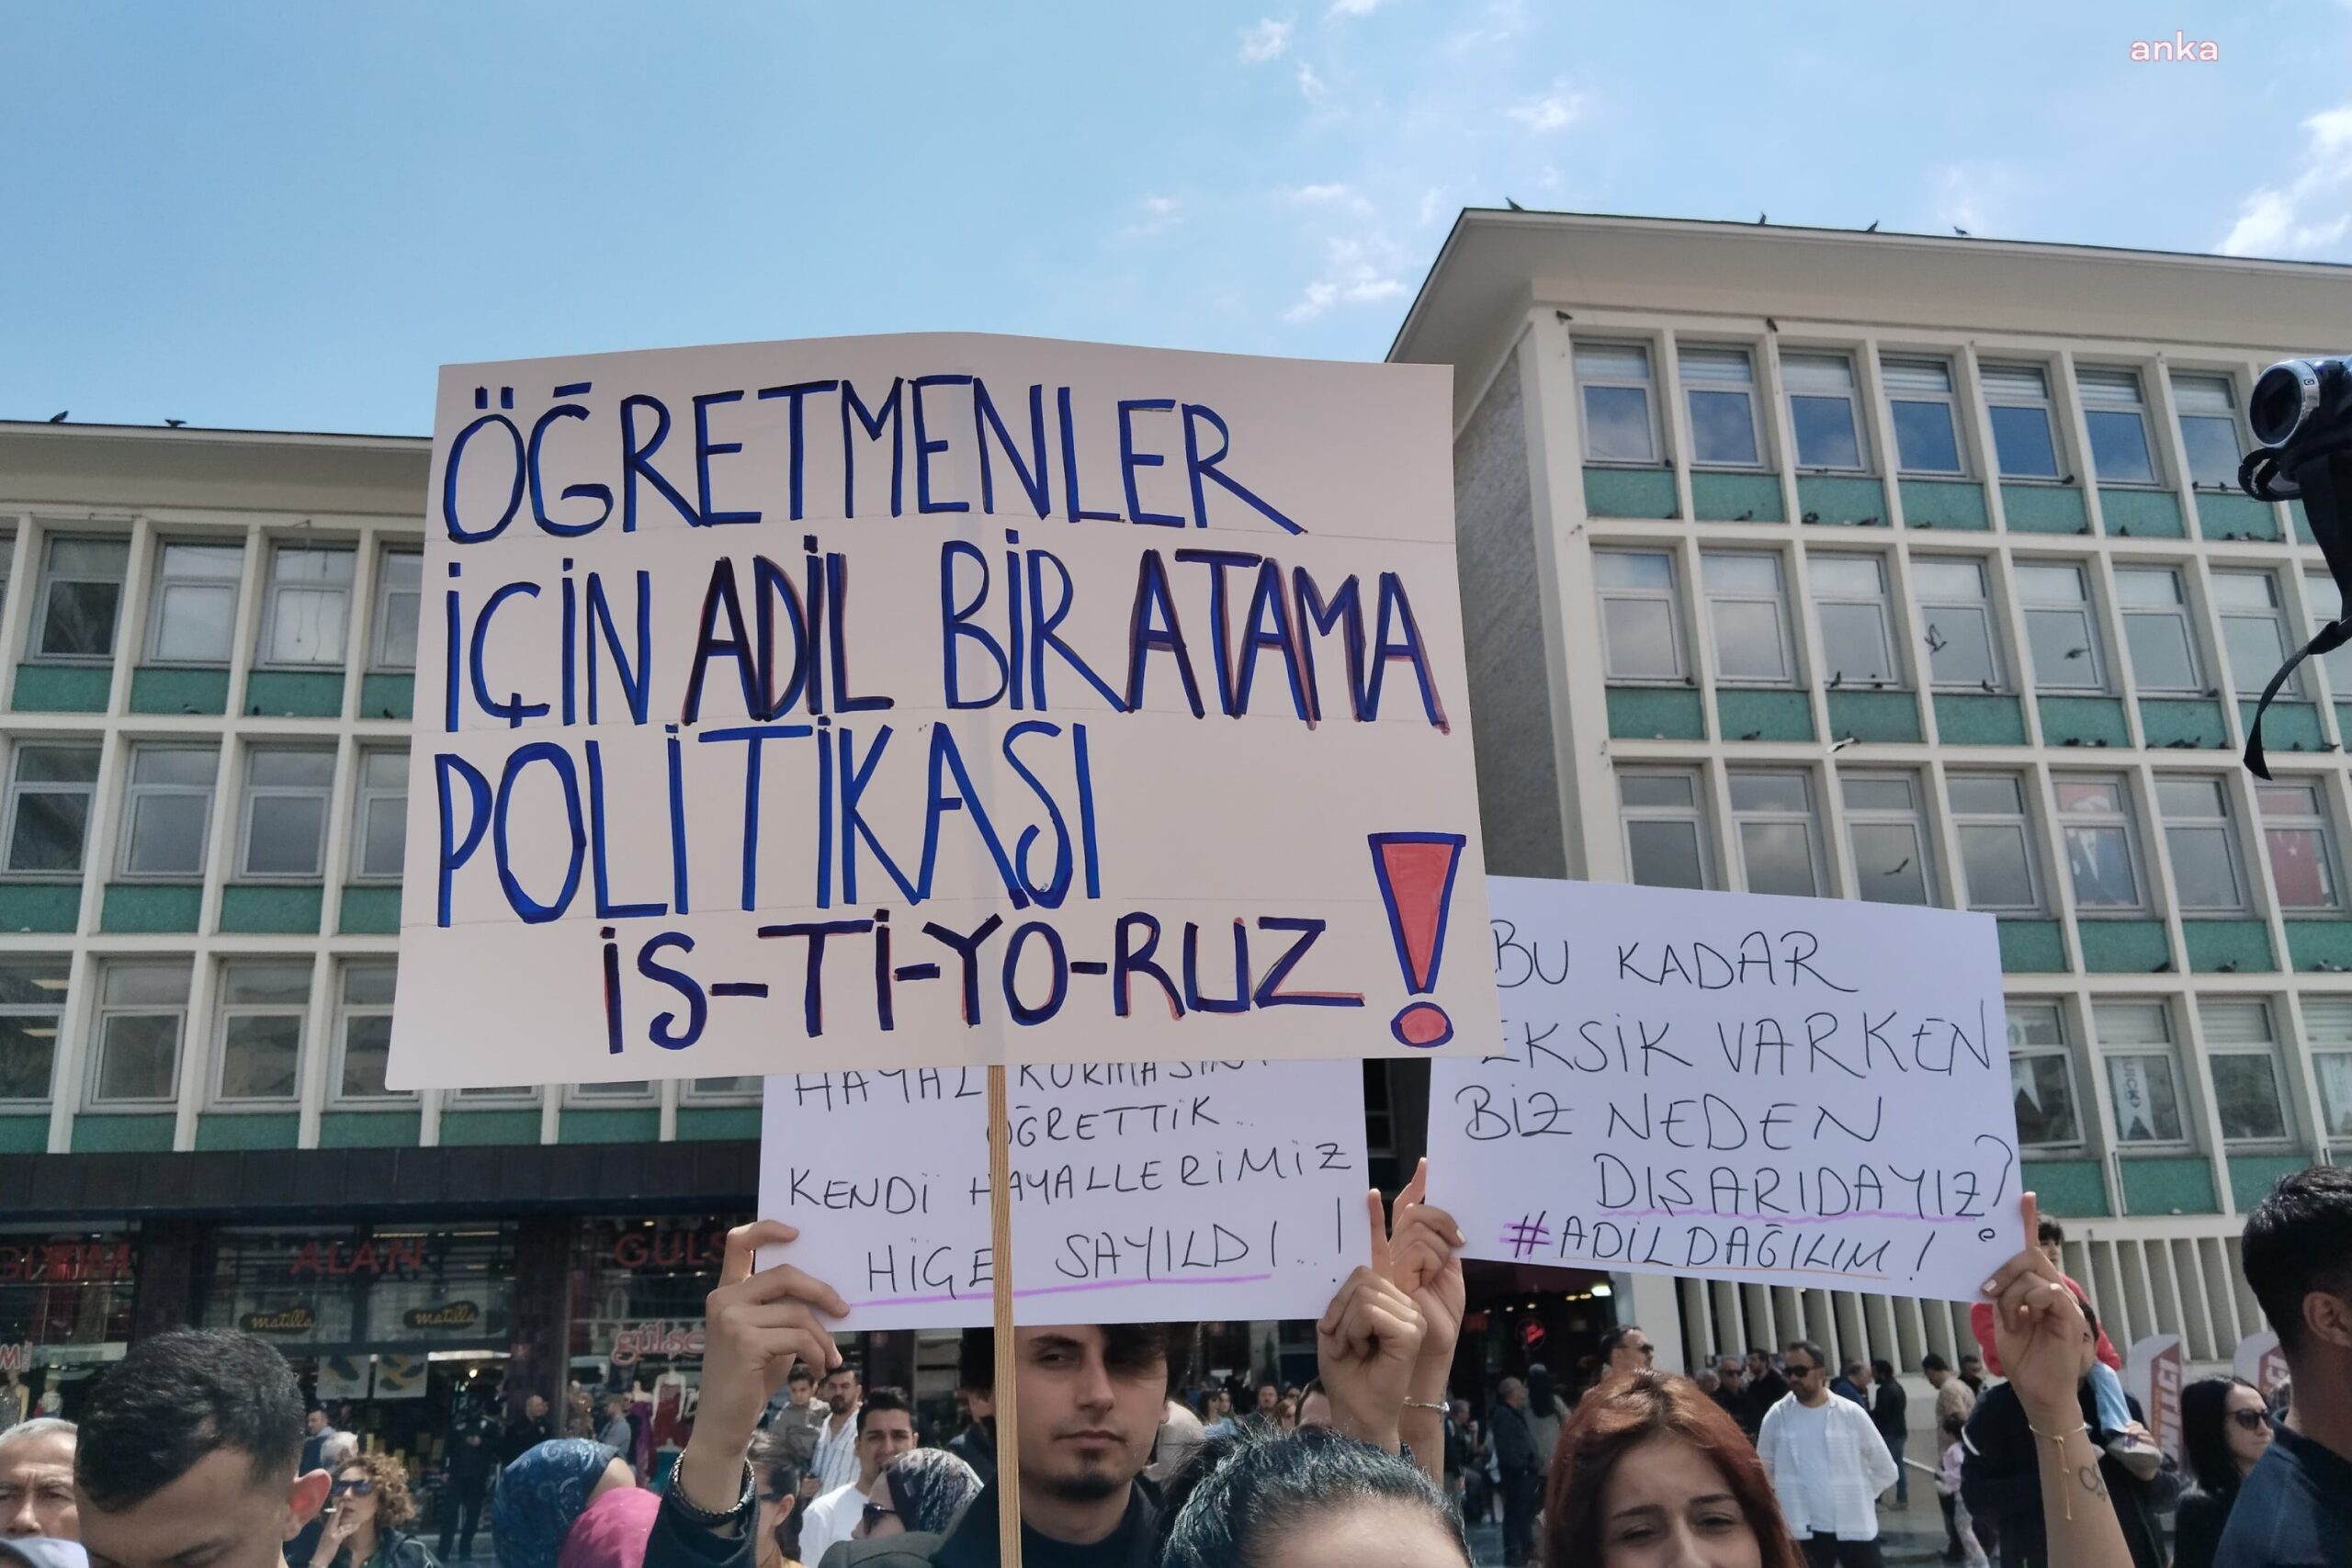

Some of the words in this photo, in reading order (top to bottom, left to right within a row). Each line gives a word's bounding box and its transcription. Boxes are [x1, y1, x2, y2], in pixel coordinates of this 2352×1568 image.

[443, 375, 1308, 544] ÖĞRETMENLER
[446, 555, 651, 734] İÇİN
[682, 535, 894, 726] ADİL
[941, 528, 1136, 713] BİR
[1123, 548, 1449, 732] ATAMA
[436, 719, 1102, 929] POLİTİKASI
[1489, 919, 1568, 987] BU
[1618, 931, 1860, 992] KADAR
[1716, 998, 1990, 1078] VARKEN
[795, 1066, 982, 1111] HAYAL
[1455, 1085, 1572, 1140] BİZ
[1608, 1093, 1882, 1150] NEDEN
[791, 1168, 939, 1214] KENDİ
[289, 1239, 424, 1275] ALAN
